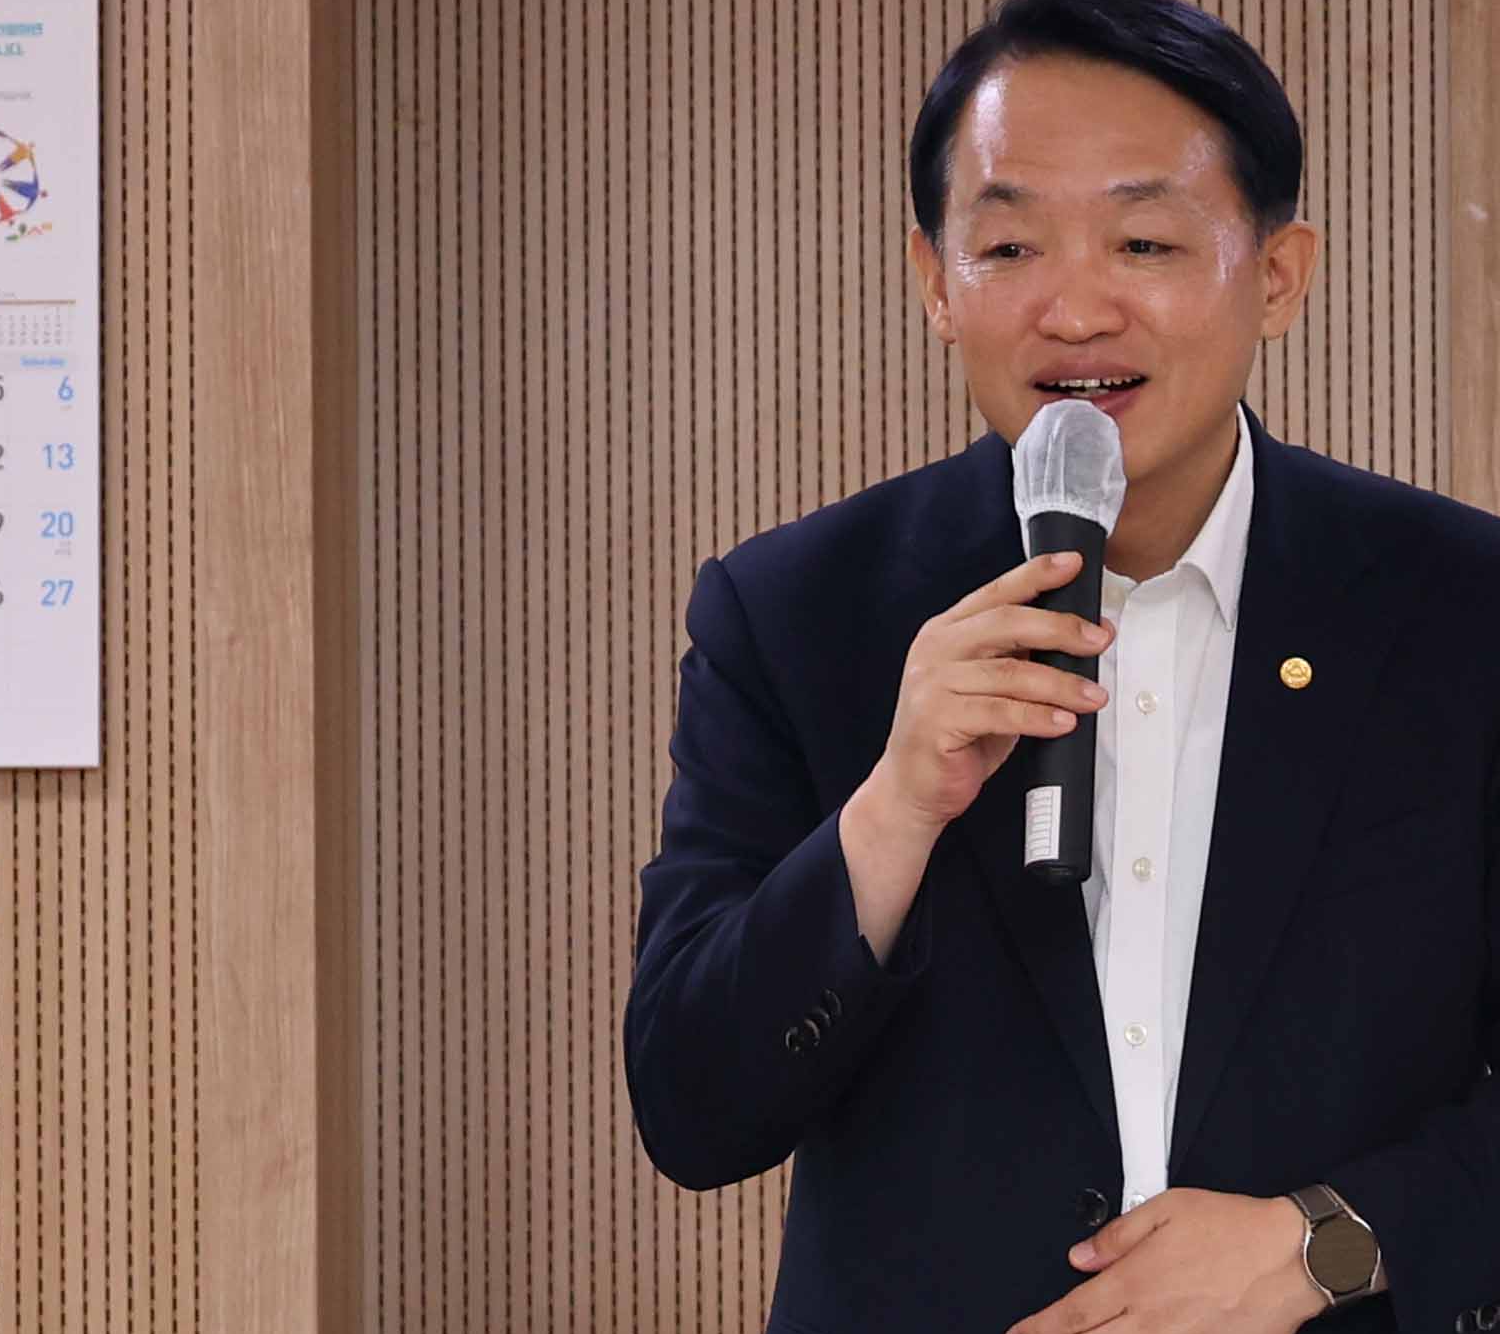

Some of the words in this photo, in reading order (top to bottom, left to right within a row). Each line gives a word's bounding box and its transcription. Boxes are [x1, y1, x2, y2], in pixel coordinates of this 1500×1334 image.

[57, 375, 75, 402] 6
[42, 442, 74, 470] 13
[40, 511, 74, 539] 20
[40, 579, 74, 607] 27
